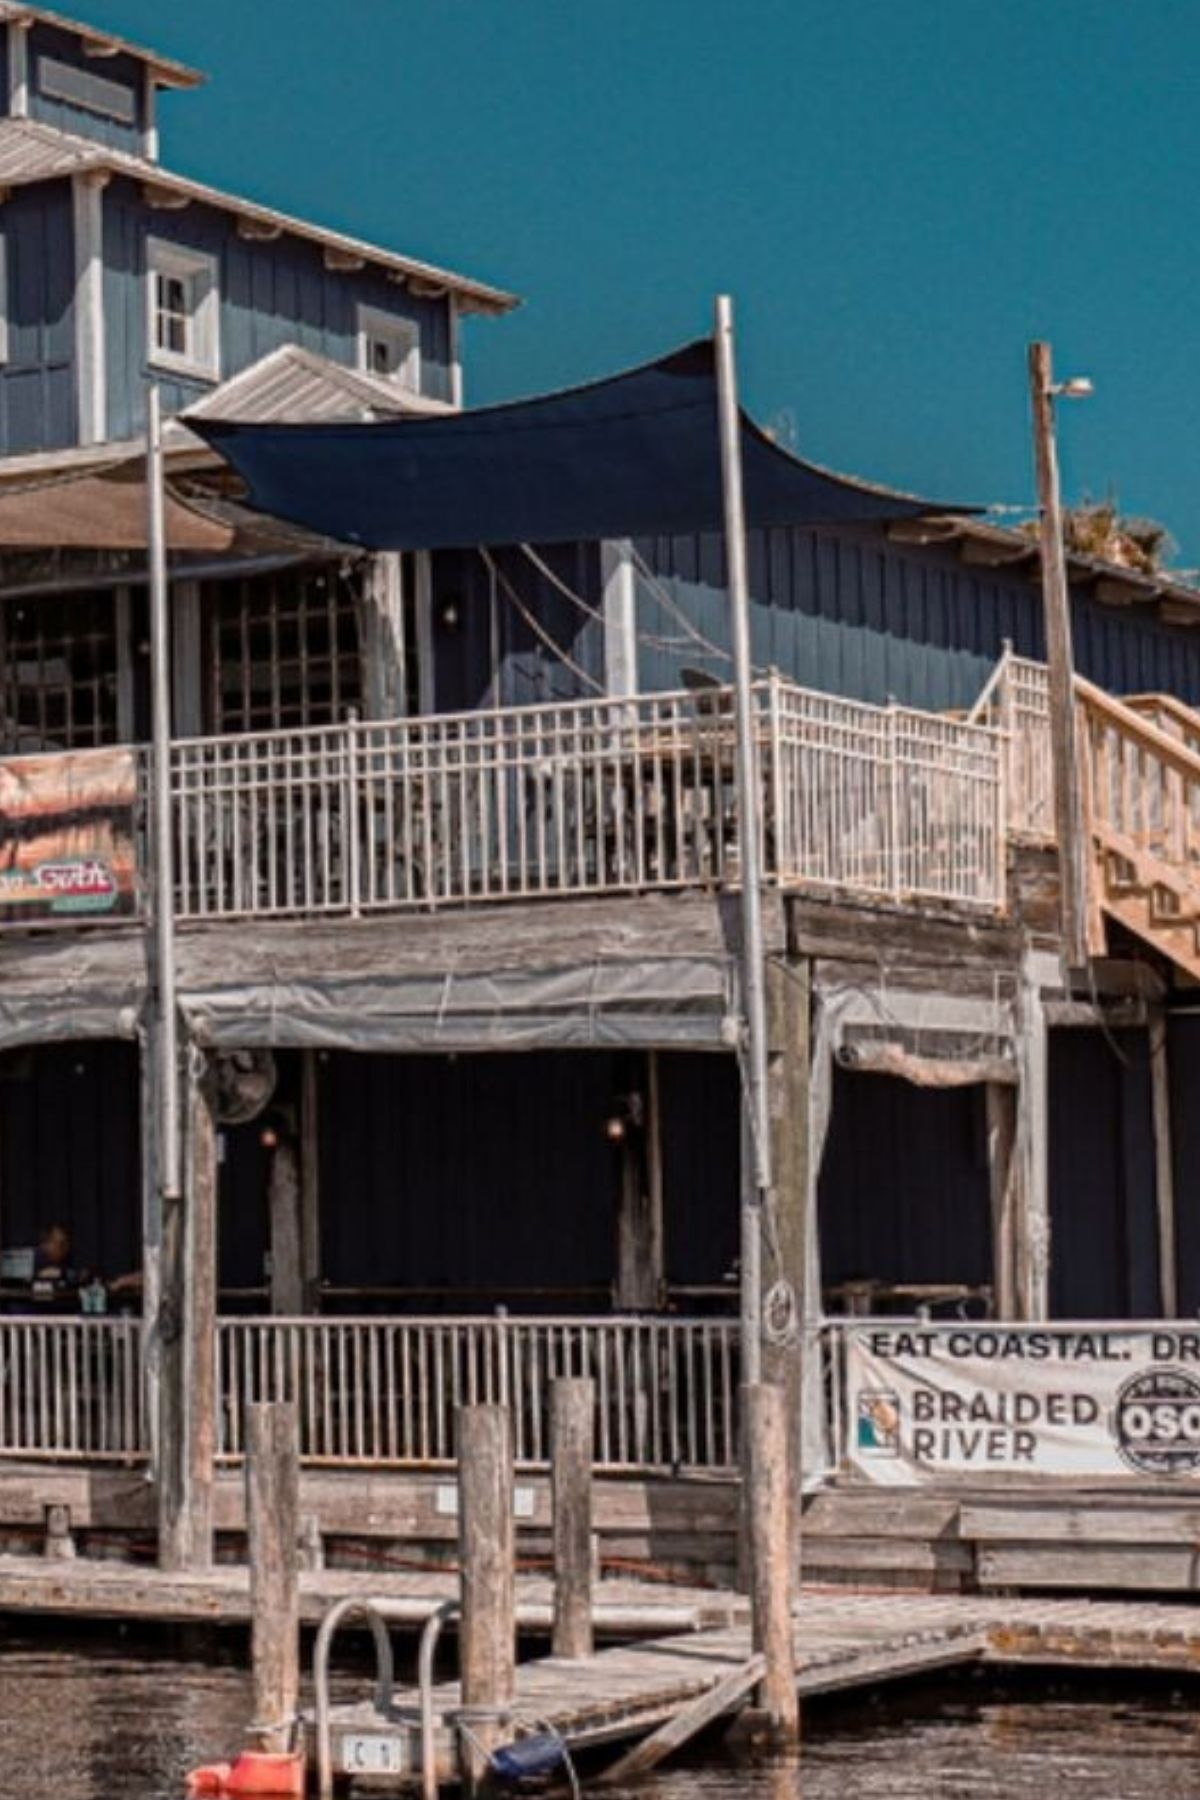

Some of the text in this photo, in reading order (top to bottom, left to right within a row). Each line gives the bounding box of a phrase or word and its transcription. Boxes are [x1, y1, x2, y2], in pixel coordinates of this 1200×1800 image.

[871, 1333, 938, 1358] EAT
[949, 1333, 1132, 1361] COASTAL.
[912, 1391, 1100, 1425] BRAIDED
[912, 1428, 1038, 1461] RIVER
